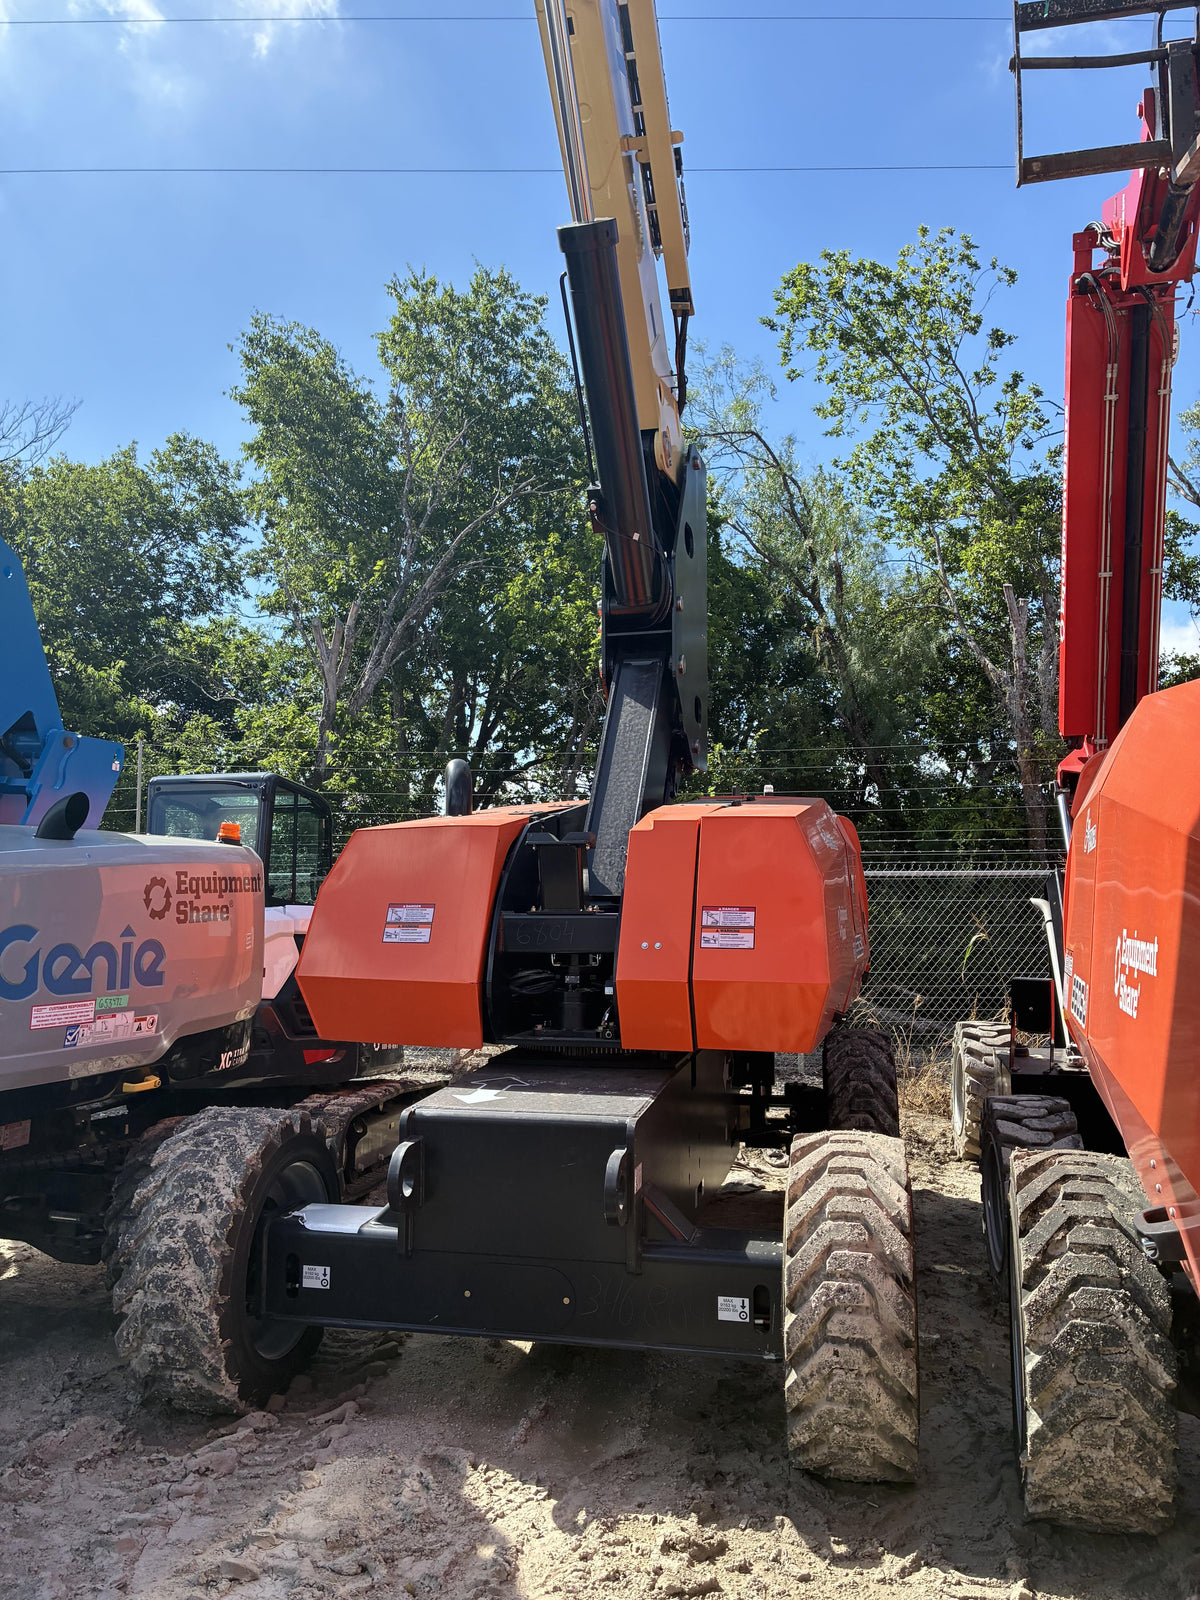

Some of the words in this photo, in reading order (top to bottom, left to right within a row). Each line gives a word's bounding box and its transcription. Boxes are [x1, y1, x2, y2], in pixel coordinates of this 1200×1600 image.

[176, 870, 261, 899] Equipment
[0, 924, 166, 1000] Genie
[1121, 928, 1158, 978] Equipment
[219, 1051, 232, 1070] XC
